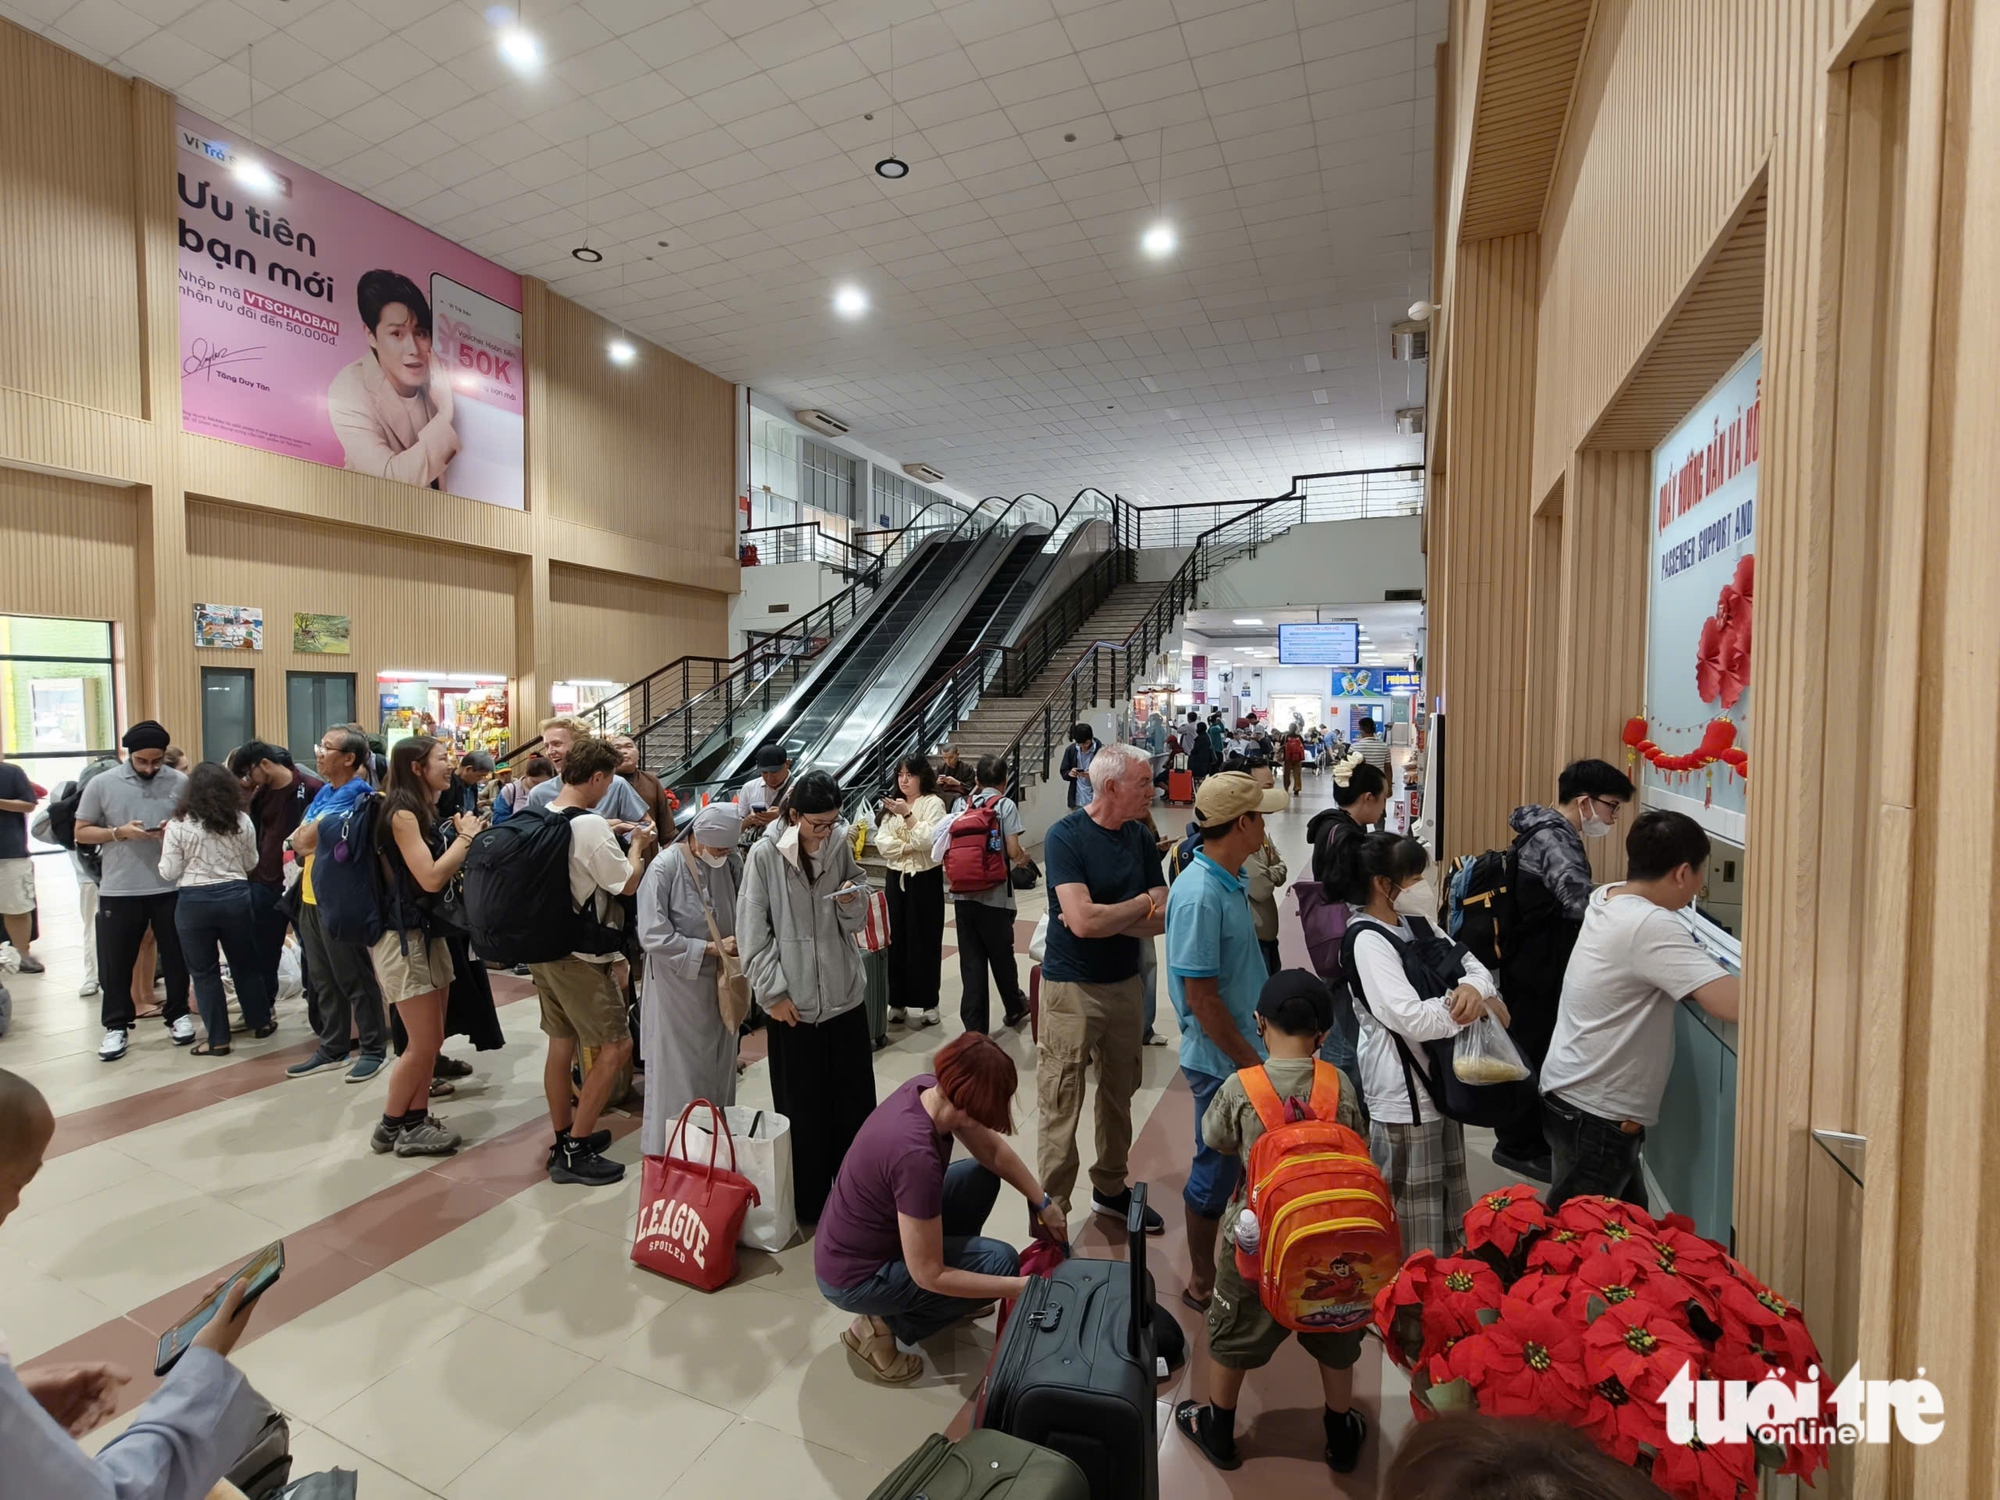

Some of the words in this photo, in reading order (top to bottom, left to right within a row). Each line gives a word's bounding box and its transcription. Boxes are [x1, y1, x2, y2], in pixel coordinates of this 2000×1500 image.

[178, 172, 233, 221] Ưu
[245, 205, 316, 257] tiên
[178, 217, 256, 275] bạn
[268, 262, 334, 303] mới
[179, 268, 215, 290] Nhập
[219, 285, 241, 299] mã
[245, 292, 338, 333] VTSCHAOBAN
[179, 286, 212, 305] nhận
[217, 299, 233, 311] ưu
[237, 306, 256, 319] đãi
[459, 343, 511, 385] 50K
[1728, 405, 1741, 480] VÀ
[1661, 536, 1695, 581] PASSENGER
[1698, 512, 1732, 562] SUPPORT
[1734, 499, 1753, 543] AND
[636, 1199, 709, 1269] LEAGUE
[649, 1241, 685, 1263] SPOILED
